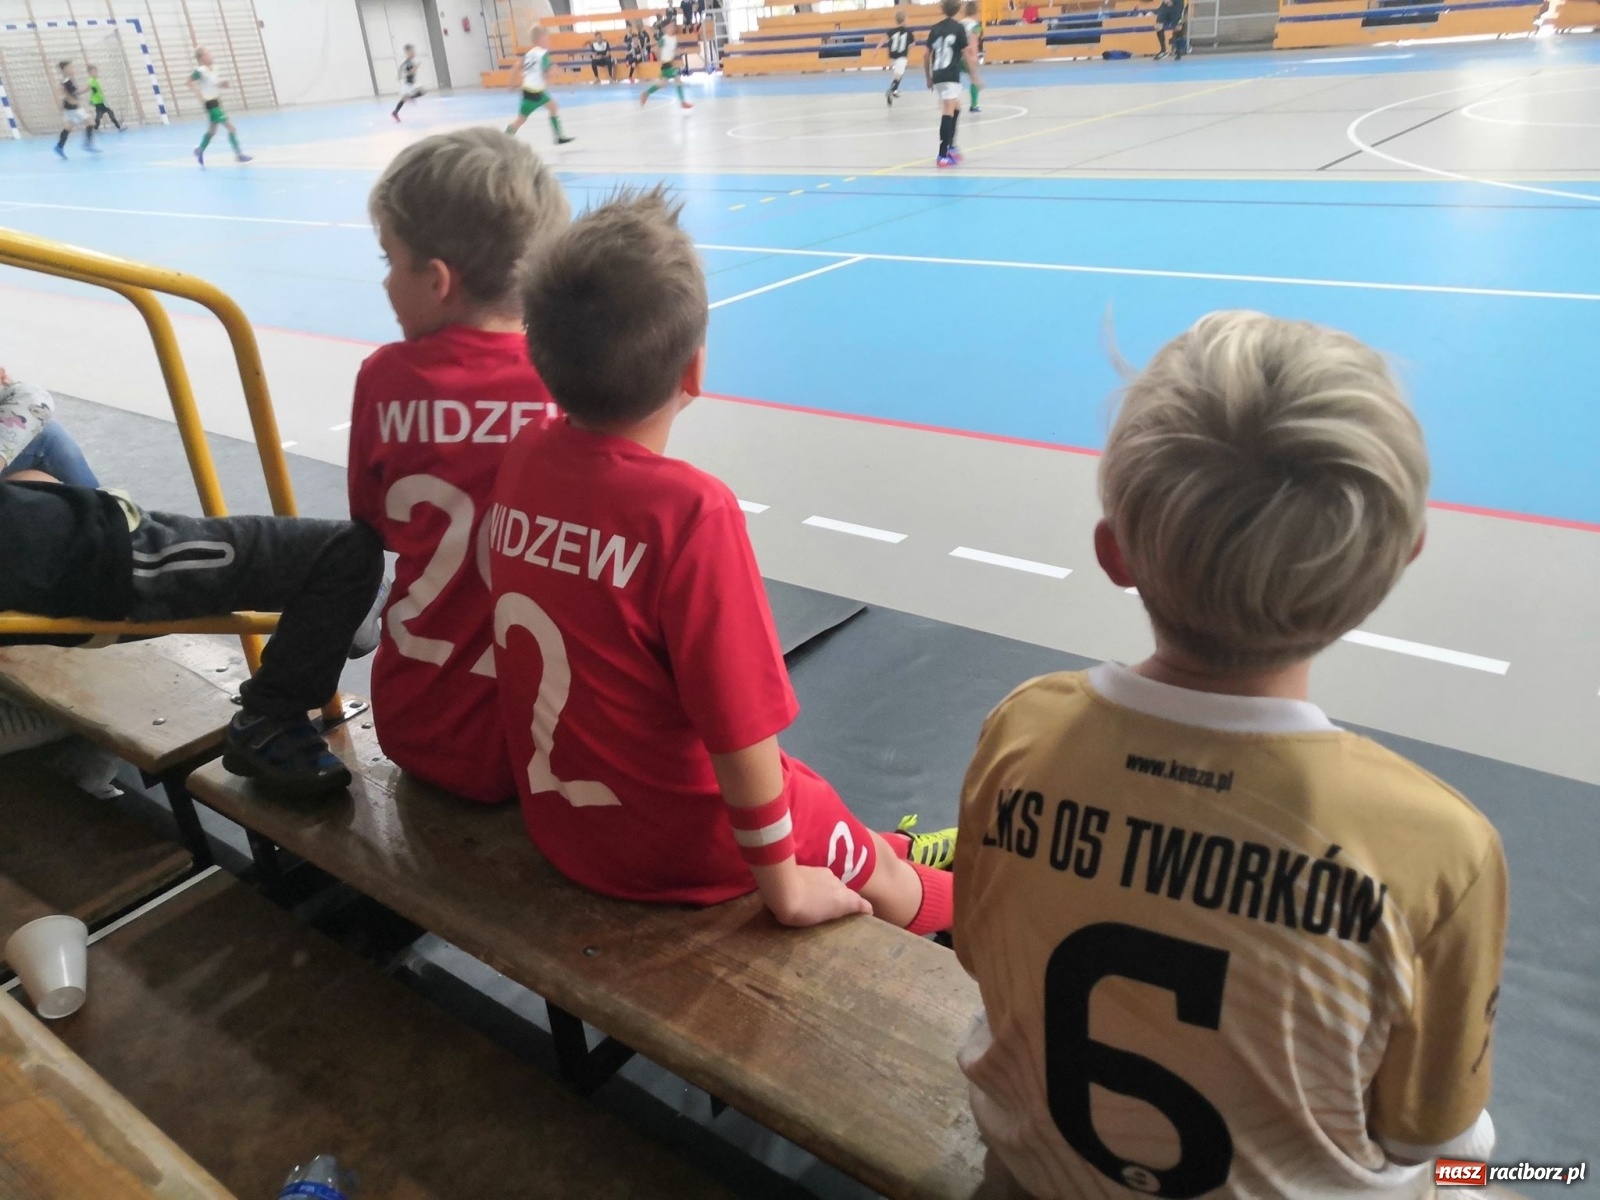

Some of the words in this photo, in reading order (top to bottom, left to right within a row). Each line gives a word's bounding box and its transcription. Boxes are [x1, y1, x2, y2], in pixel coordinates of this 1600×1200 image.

[891, 31, 908, 53] 11
[1120, 815, 1387, 944] TWORKÓW
[1044, 921, 1231, 1199] 6
